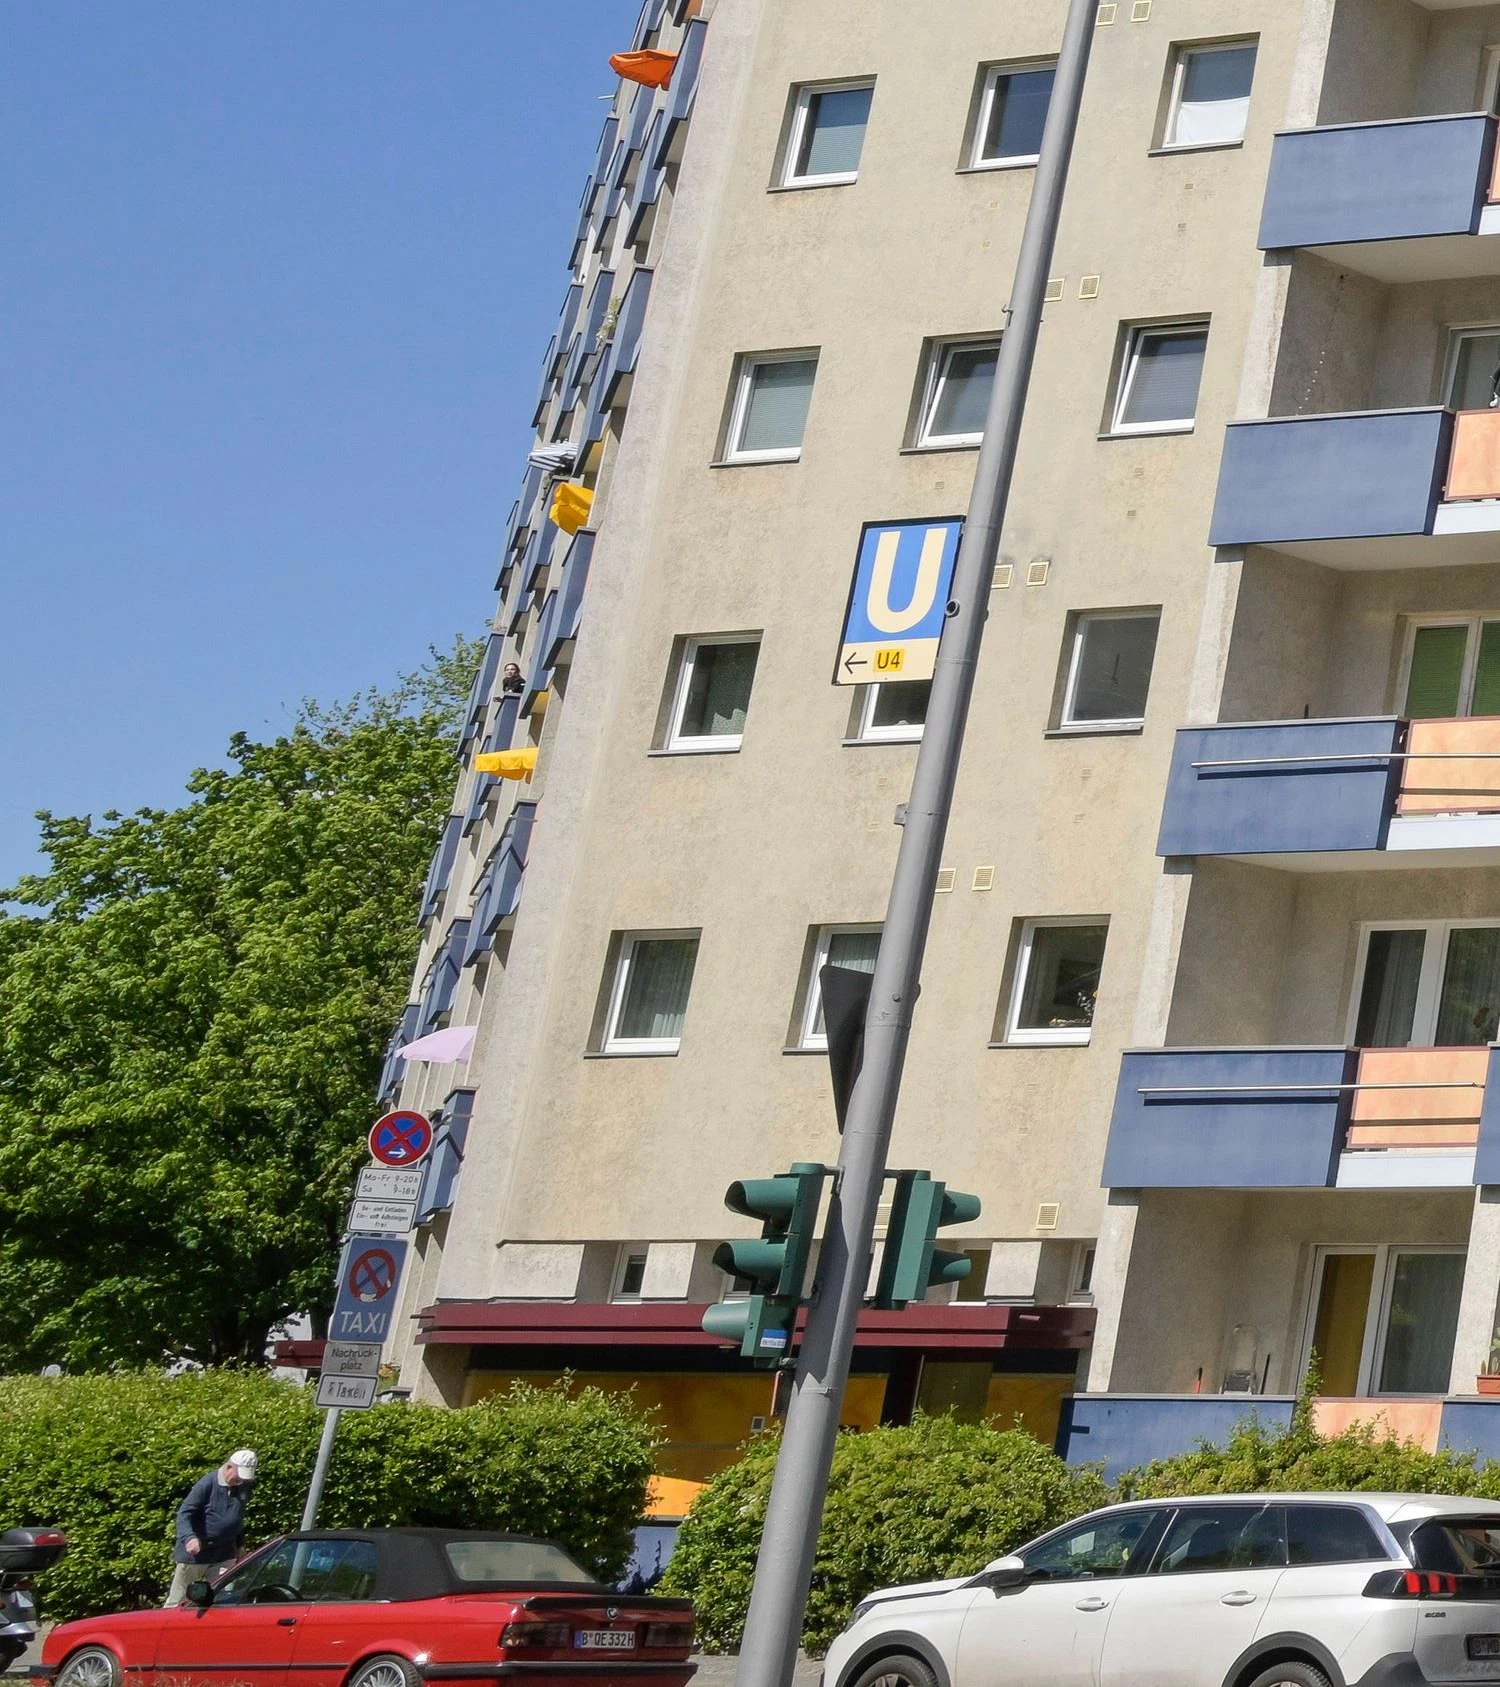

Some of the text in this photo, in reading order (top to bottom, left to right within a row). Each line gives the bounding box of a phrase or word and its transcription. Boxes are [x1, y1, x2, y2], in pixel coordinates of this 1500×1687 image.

[866, 527, 948, 633] U
[876, 651, 901, 669] U4
[364, 1174, 391, 1183] Mo-Fr
[362, 1185, 372, 1193] Sa
[340, 1311, 387, 1334] TAXI
[340, 1361, 362, 1372] platz
[582, 1632, 588, 1645] B
